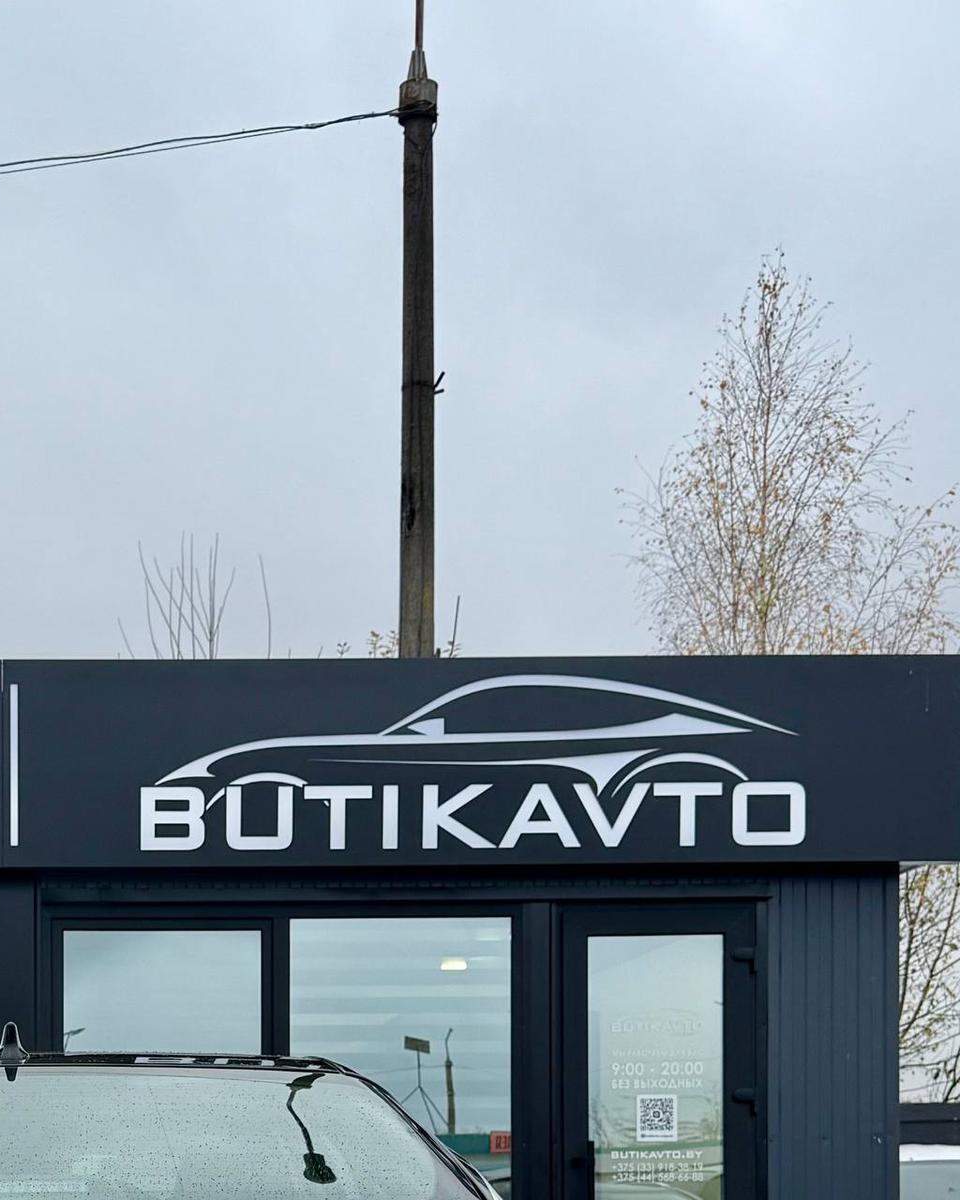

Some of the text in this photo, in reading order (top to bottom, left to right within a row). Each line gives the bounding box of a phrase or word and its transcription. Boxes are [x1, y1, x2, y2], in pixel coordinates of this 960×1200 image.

[140, 781, 806, 851] BUTIKAVTO
[611, 1062, 644, 1075] 9:00
[660, 1062, 703, 1075] 20:00
[611, 1079, 703, 1089] БЕЗ ВЫХОДНЫХ
[610, 1150, 703, 1159] BUTIKAVTO.BY
[611, 1162, 635, 1172] +375
[637, 1162, 655, 1173] (33)
